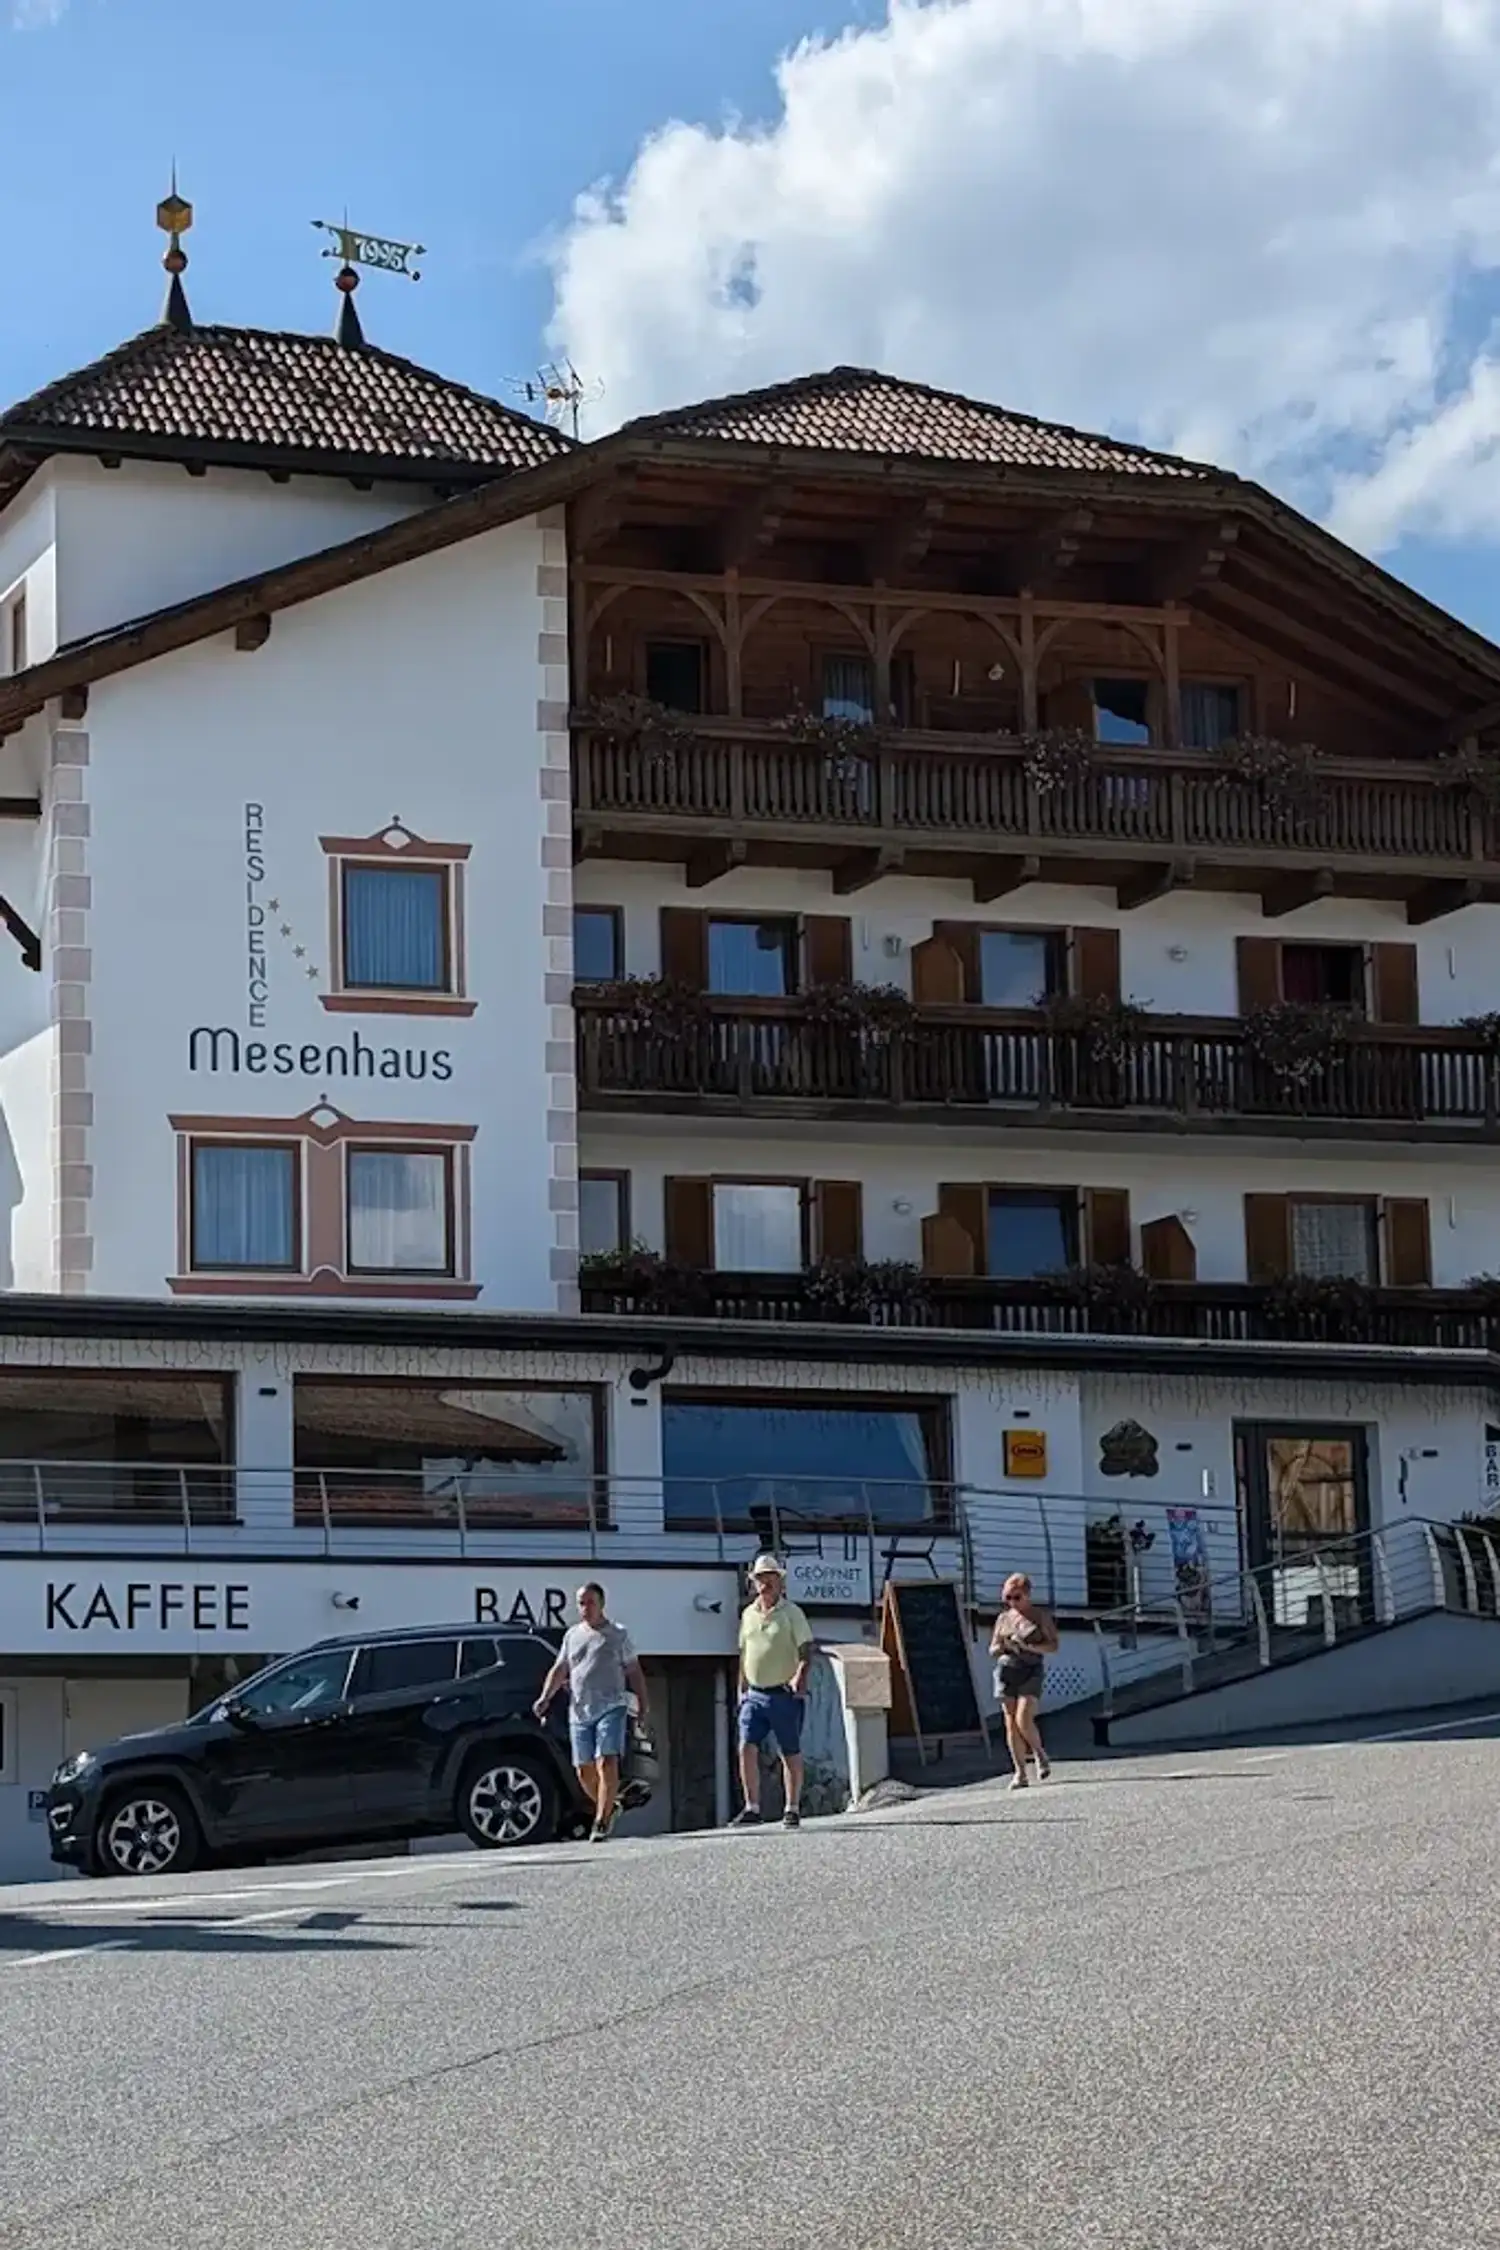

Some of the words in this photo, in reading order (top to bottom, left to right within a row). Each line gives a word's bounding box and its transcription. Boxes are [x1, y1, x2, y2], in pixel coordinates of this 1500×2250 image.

[245, 802, 268, 1029] RESIDENCE
[189, 1026, 454, 1081] Mesenhaus
[1484, 1443, 1500, 1487] BAR
[46, 1582, 249, 1630] KAFFEE
[475, 1587, 568, 1628] BAR
